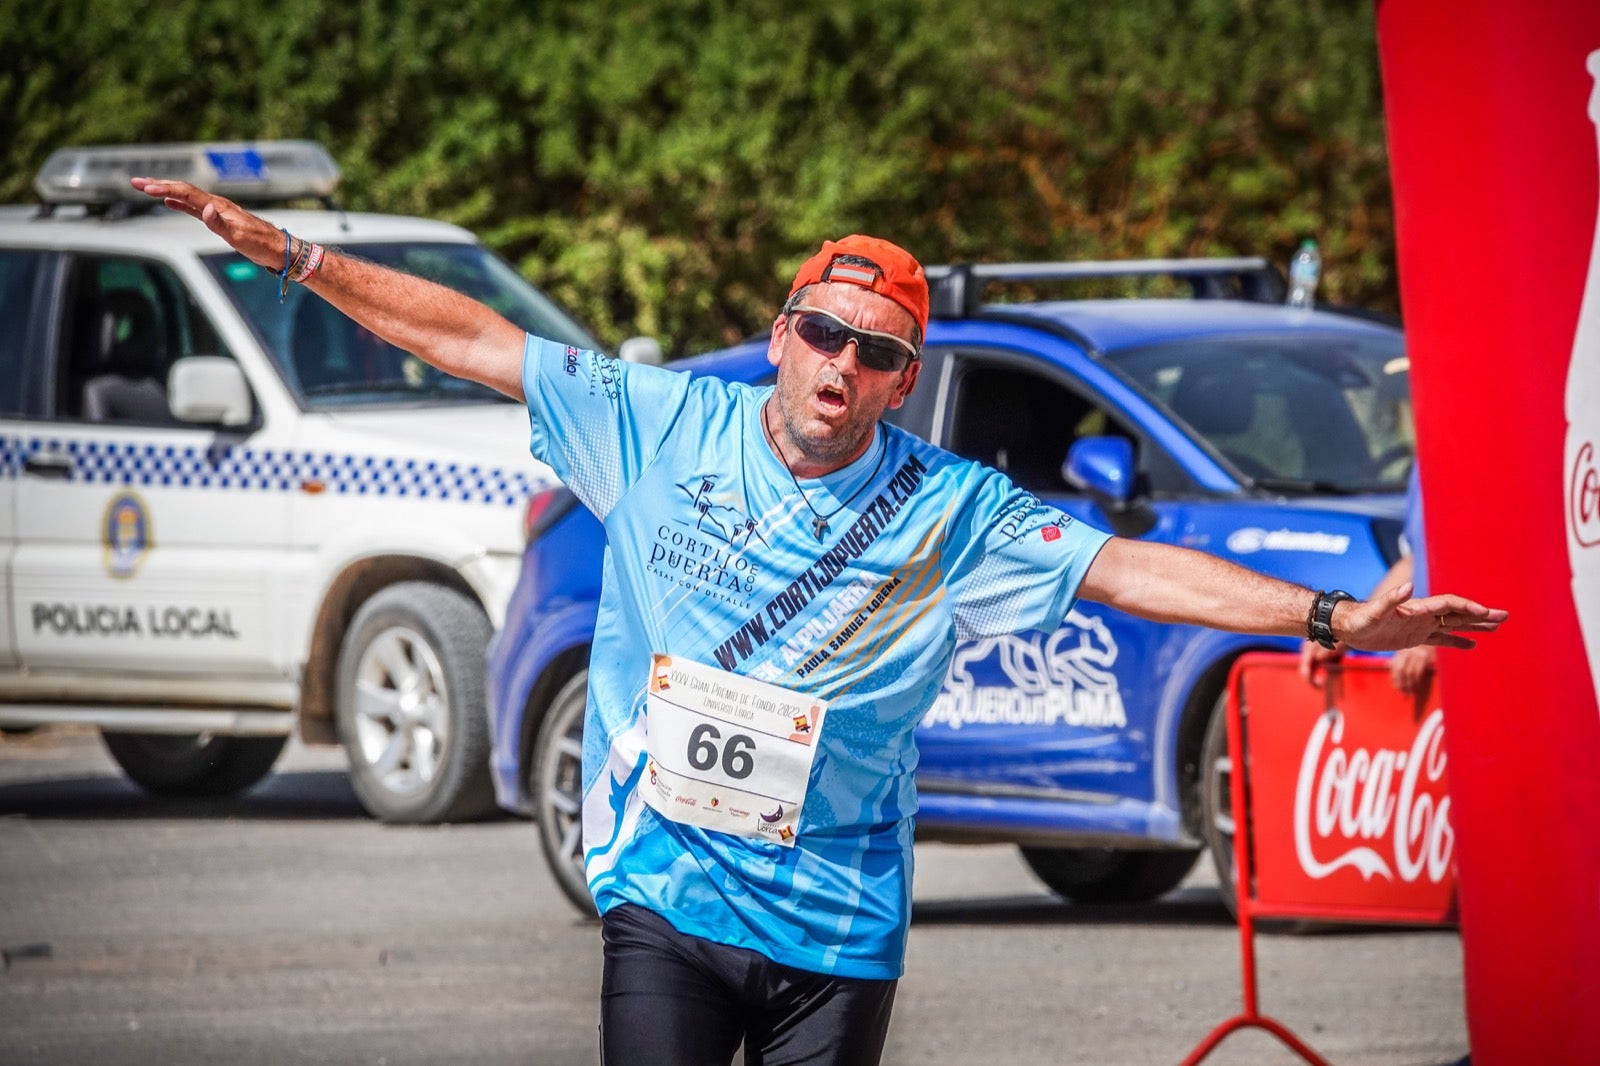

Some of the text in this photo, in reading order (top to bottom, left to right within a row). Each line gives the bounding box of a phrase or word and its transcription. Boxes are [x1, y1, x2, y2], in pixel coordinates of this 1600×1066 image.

[648, 542, 741, 593] PUERTA
[658, 525, 748, 571] CORTIJO
[713, 453, 928, 672] WWW.CORTIJOPUERTA.COM
[646, 564, 751, 609] CASAS CON DETALLE
[744, 563, 760, 597] .com
[31, 602, 240, 639] POLICIA LOCAL
[783, 570, 881, 666] ALPUJARRA
[796, 576, 902, 679] PAULA SAMUEL LORENA
[777, 703, 800, 719] 2022
[687, 723, 757, 780] 66
[757, 819, 778, 835] Lorca
